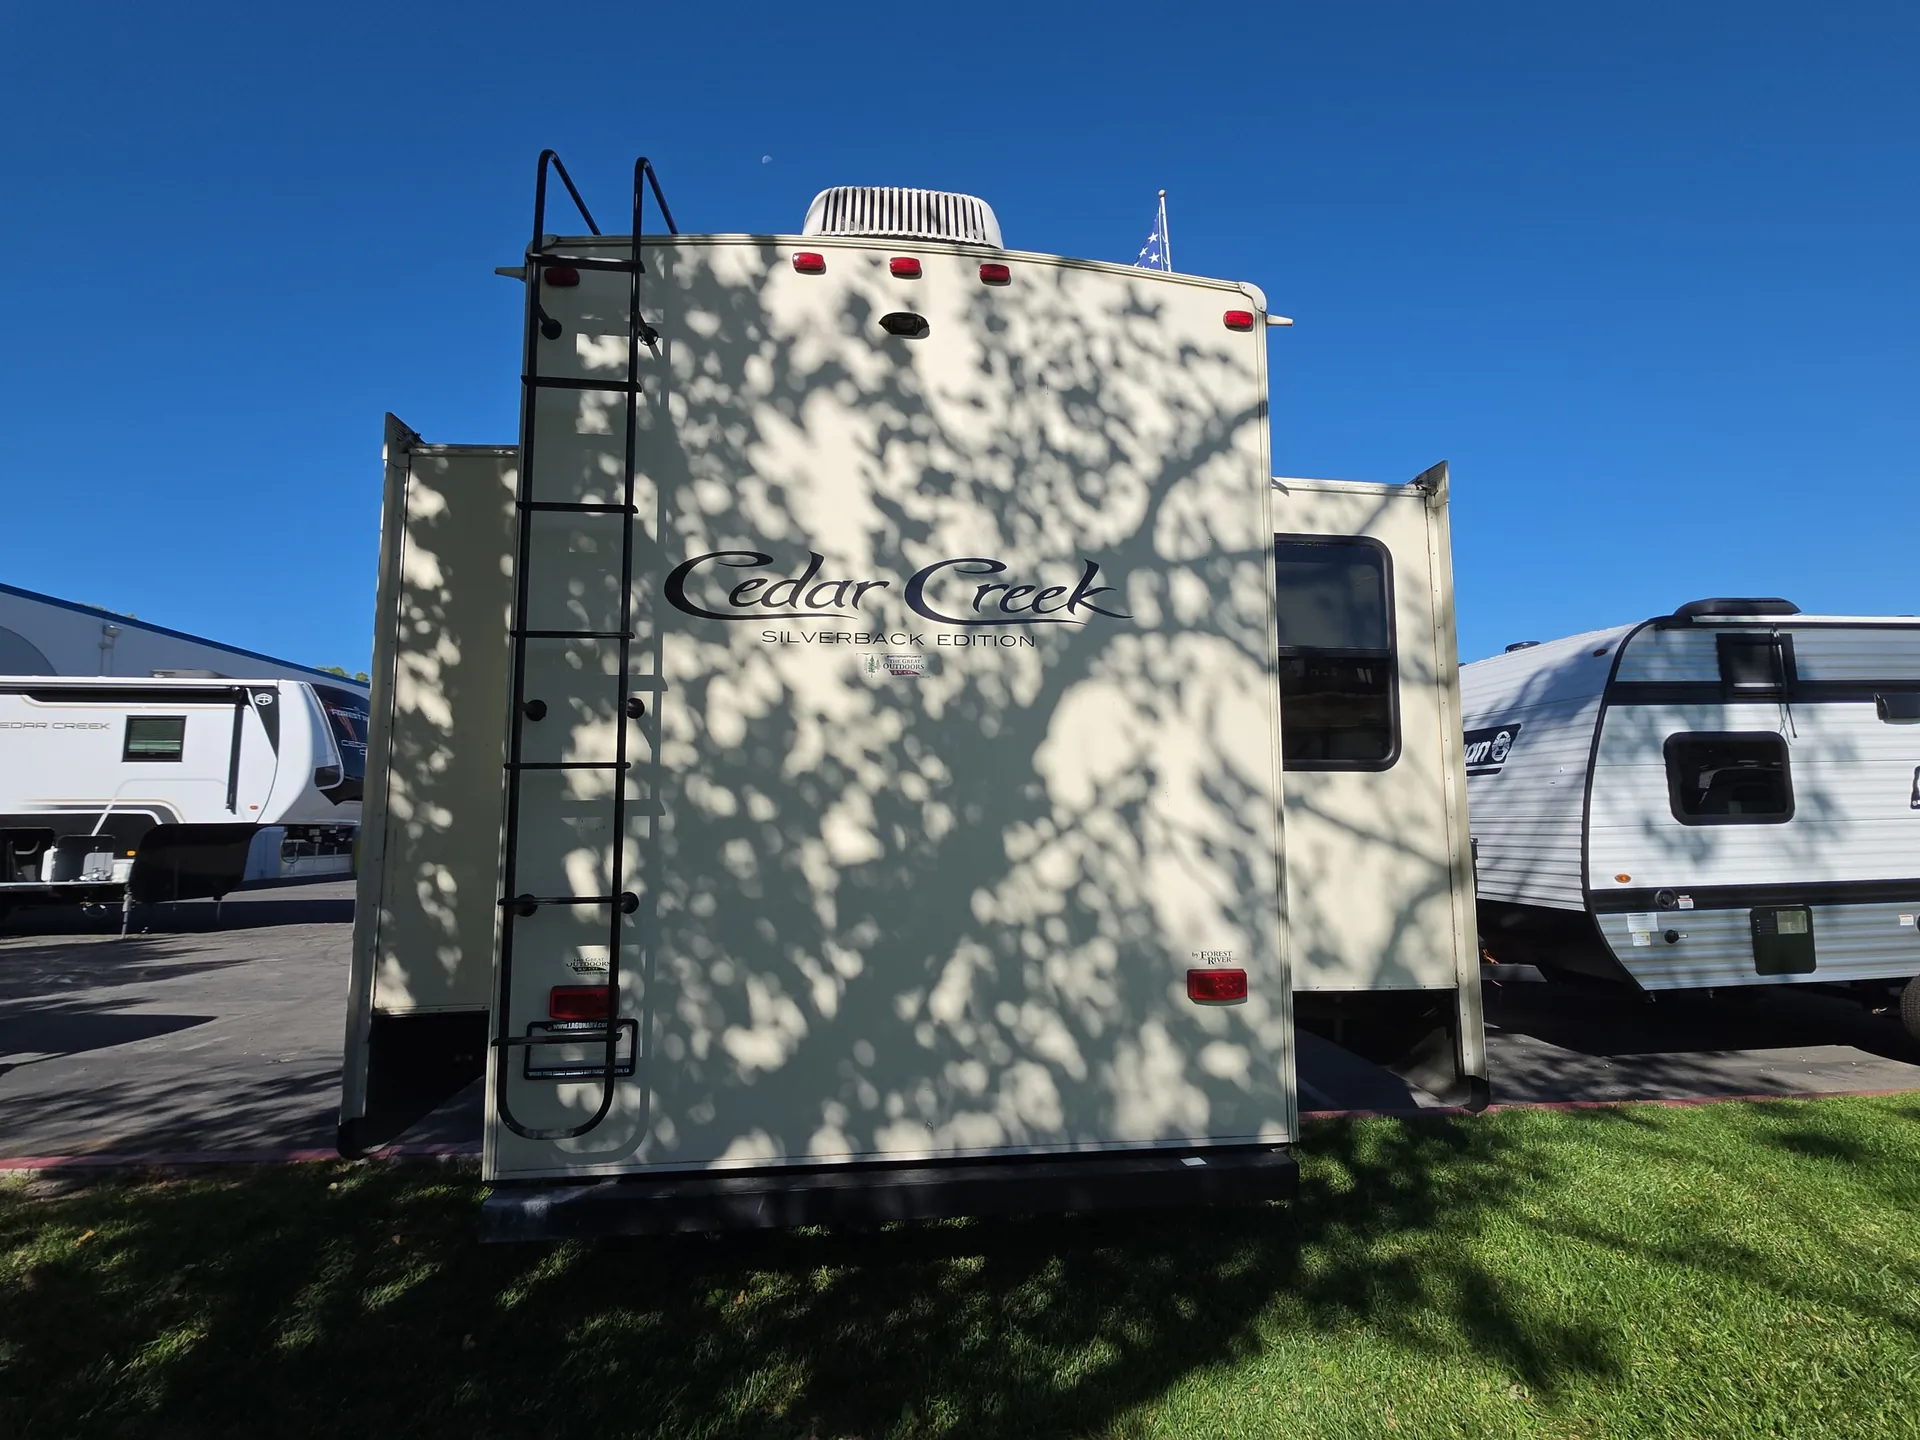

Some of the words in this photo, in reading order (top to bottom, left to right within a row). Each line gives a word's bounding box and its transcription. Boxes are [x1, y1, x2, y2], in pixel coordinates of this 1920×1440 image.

[664, 551, 889, 620] Cedar
[904, 557, 1134, 626] Creek
[761, 630, 925, 646] SILVERBACK
[937, 634, 1035, 648] EDITION
[52, 722, 110, 730] CREEK
[341, 739, 367, 747] CEDA
[1201, 951, 1232, 959] FOREST
